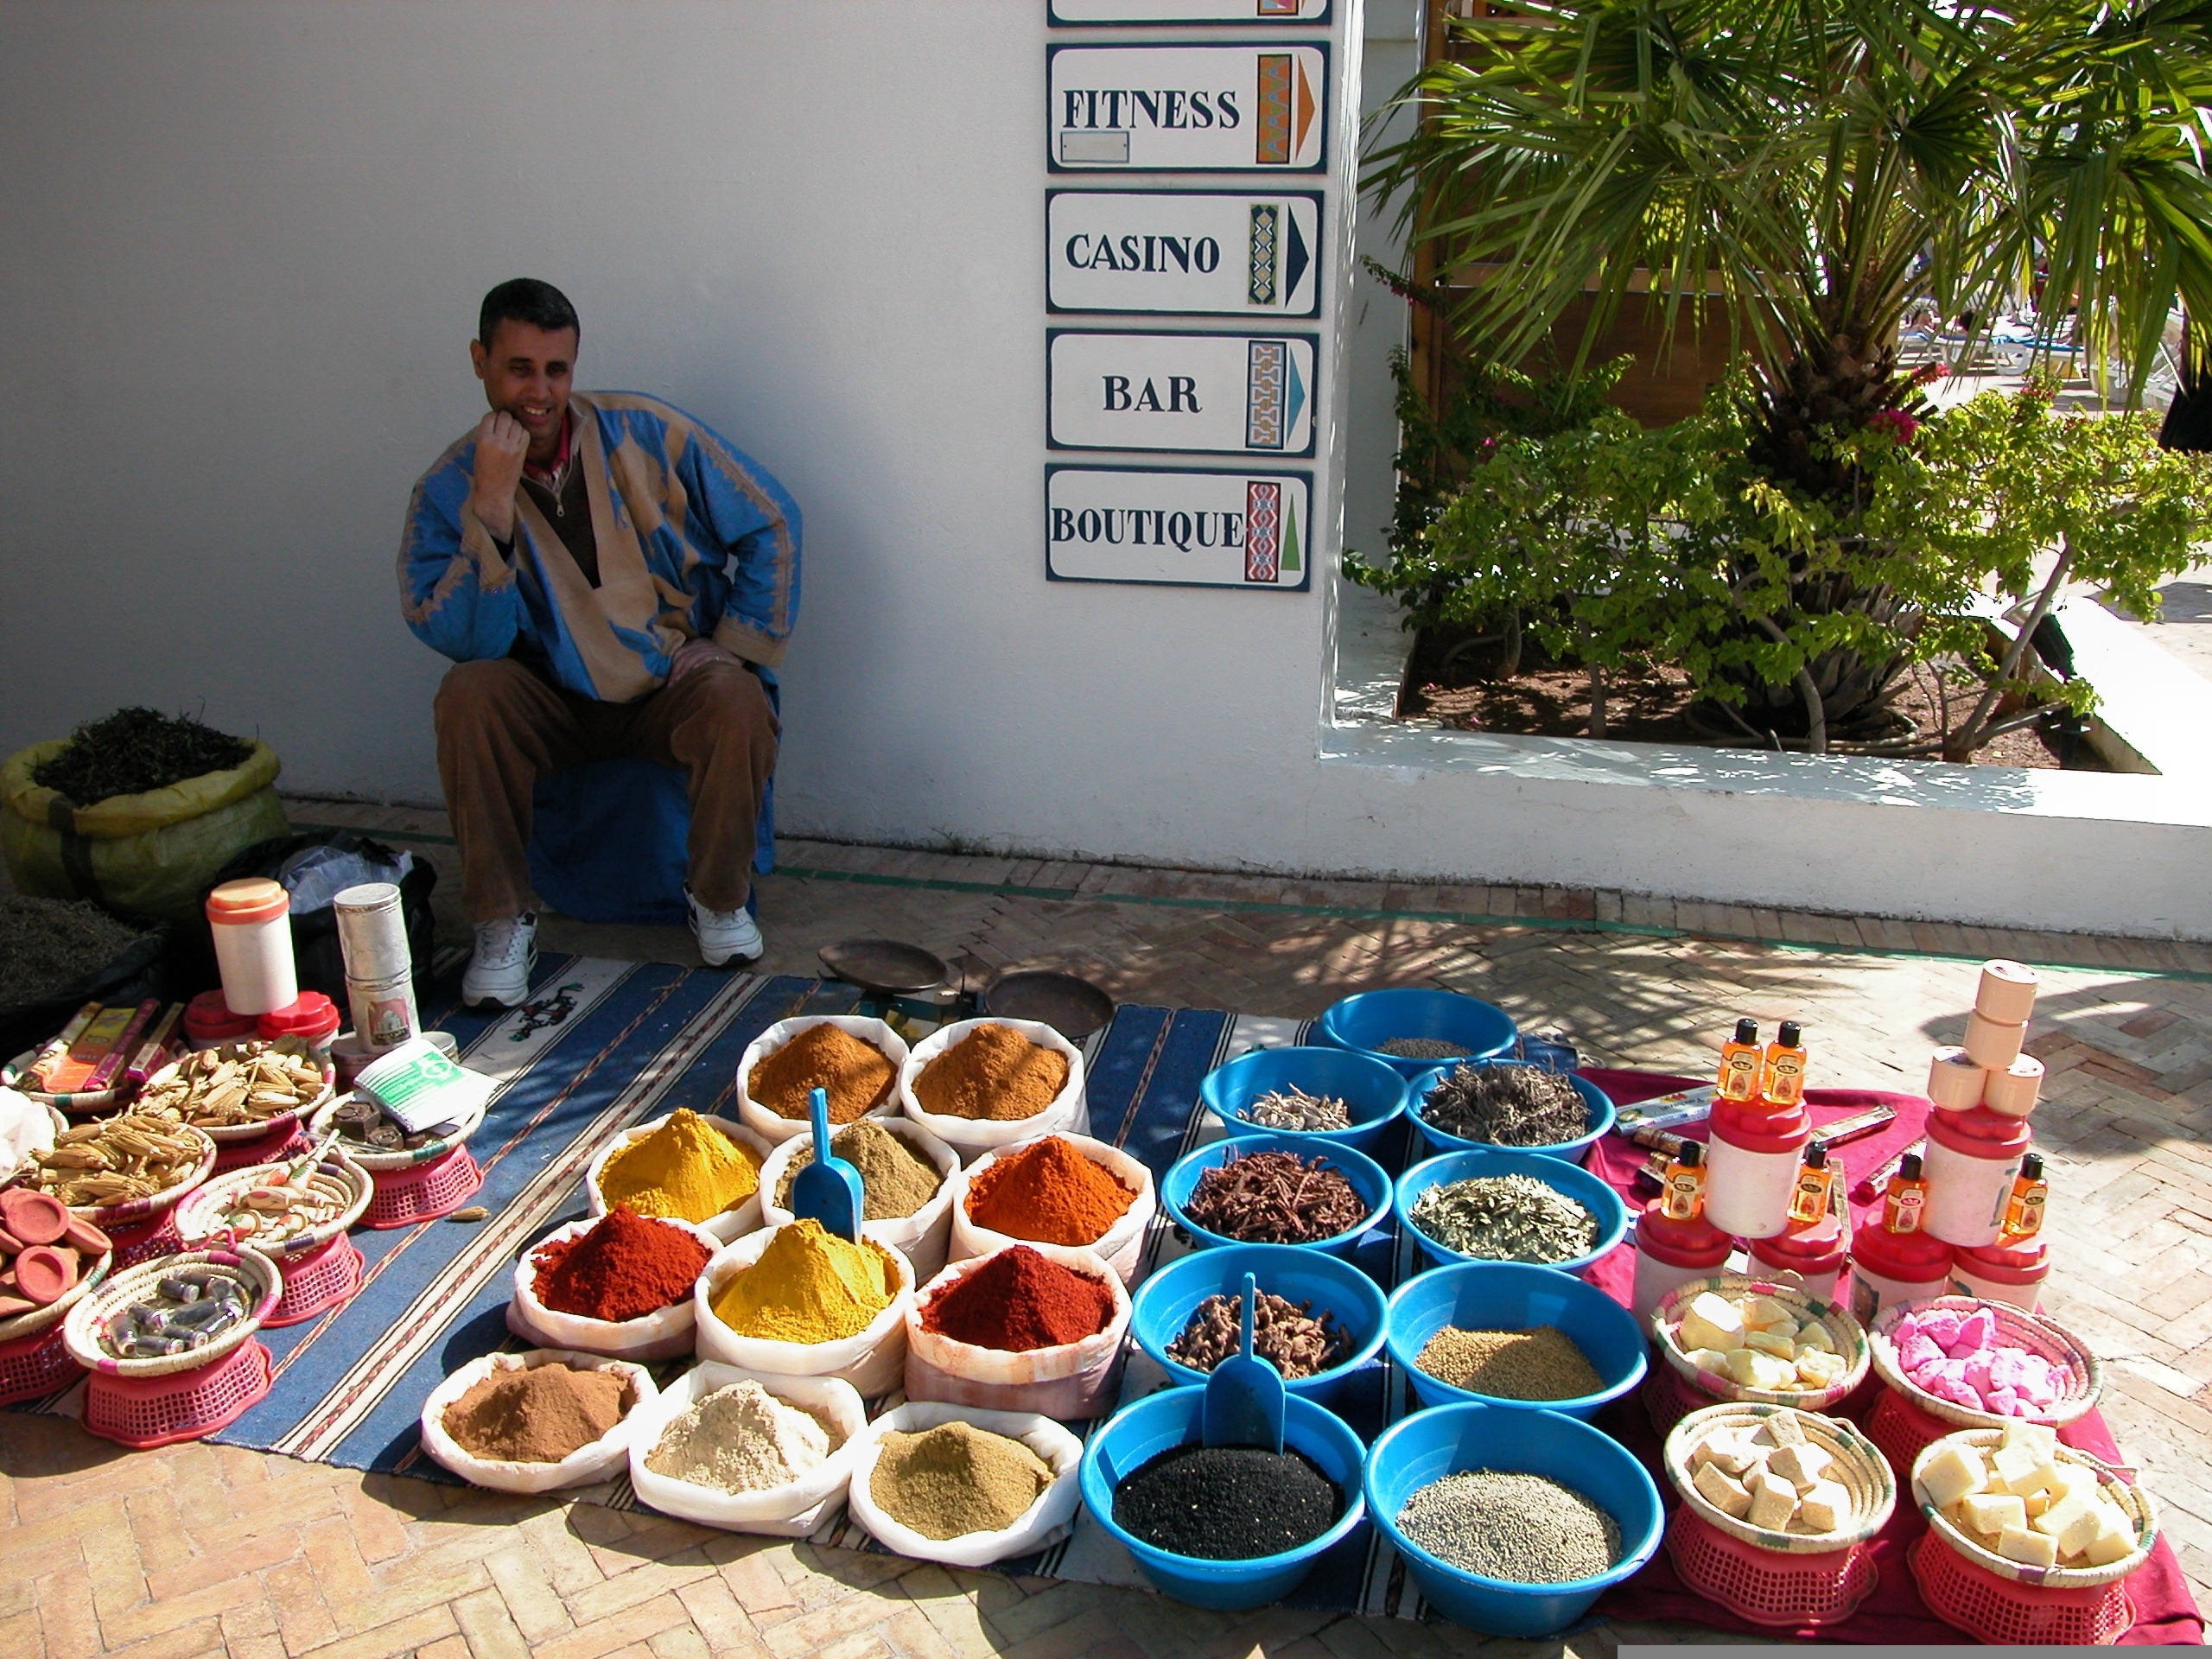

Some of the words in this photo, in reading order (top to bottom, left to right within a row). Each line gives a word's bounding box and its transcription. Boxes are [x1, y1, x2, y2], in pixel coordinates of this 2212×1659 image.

[1063, 90, 1240, 129] FITNESS
[1065, 234, 1220, 274] CASINO
[1103, 375, 1203, 414] BAR
[1052, 507, 1245, 553] BOUTIQUE
